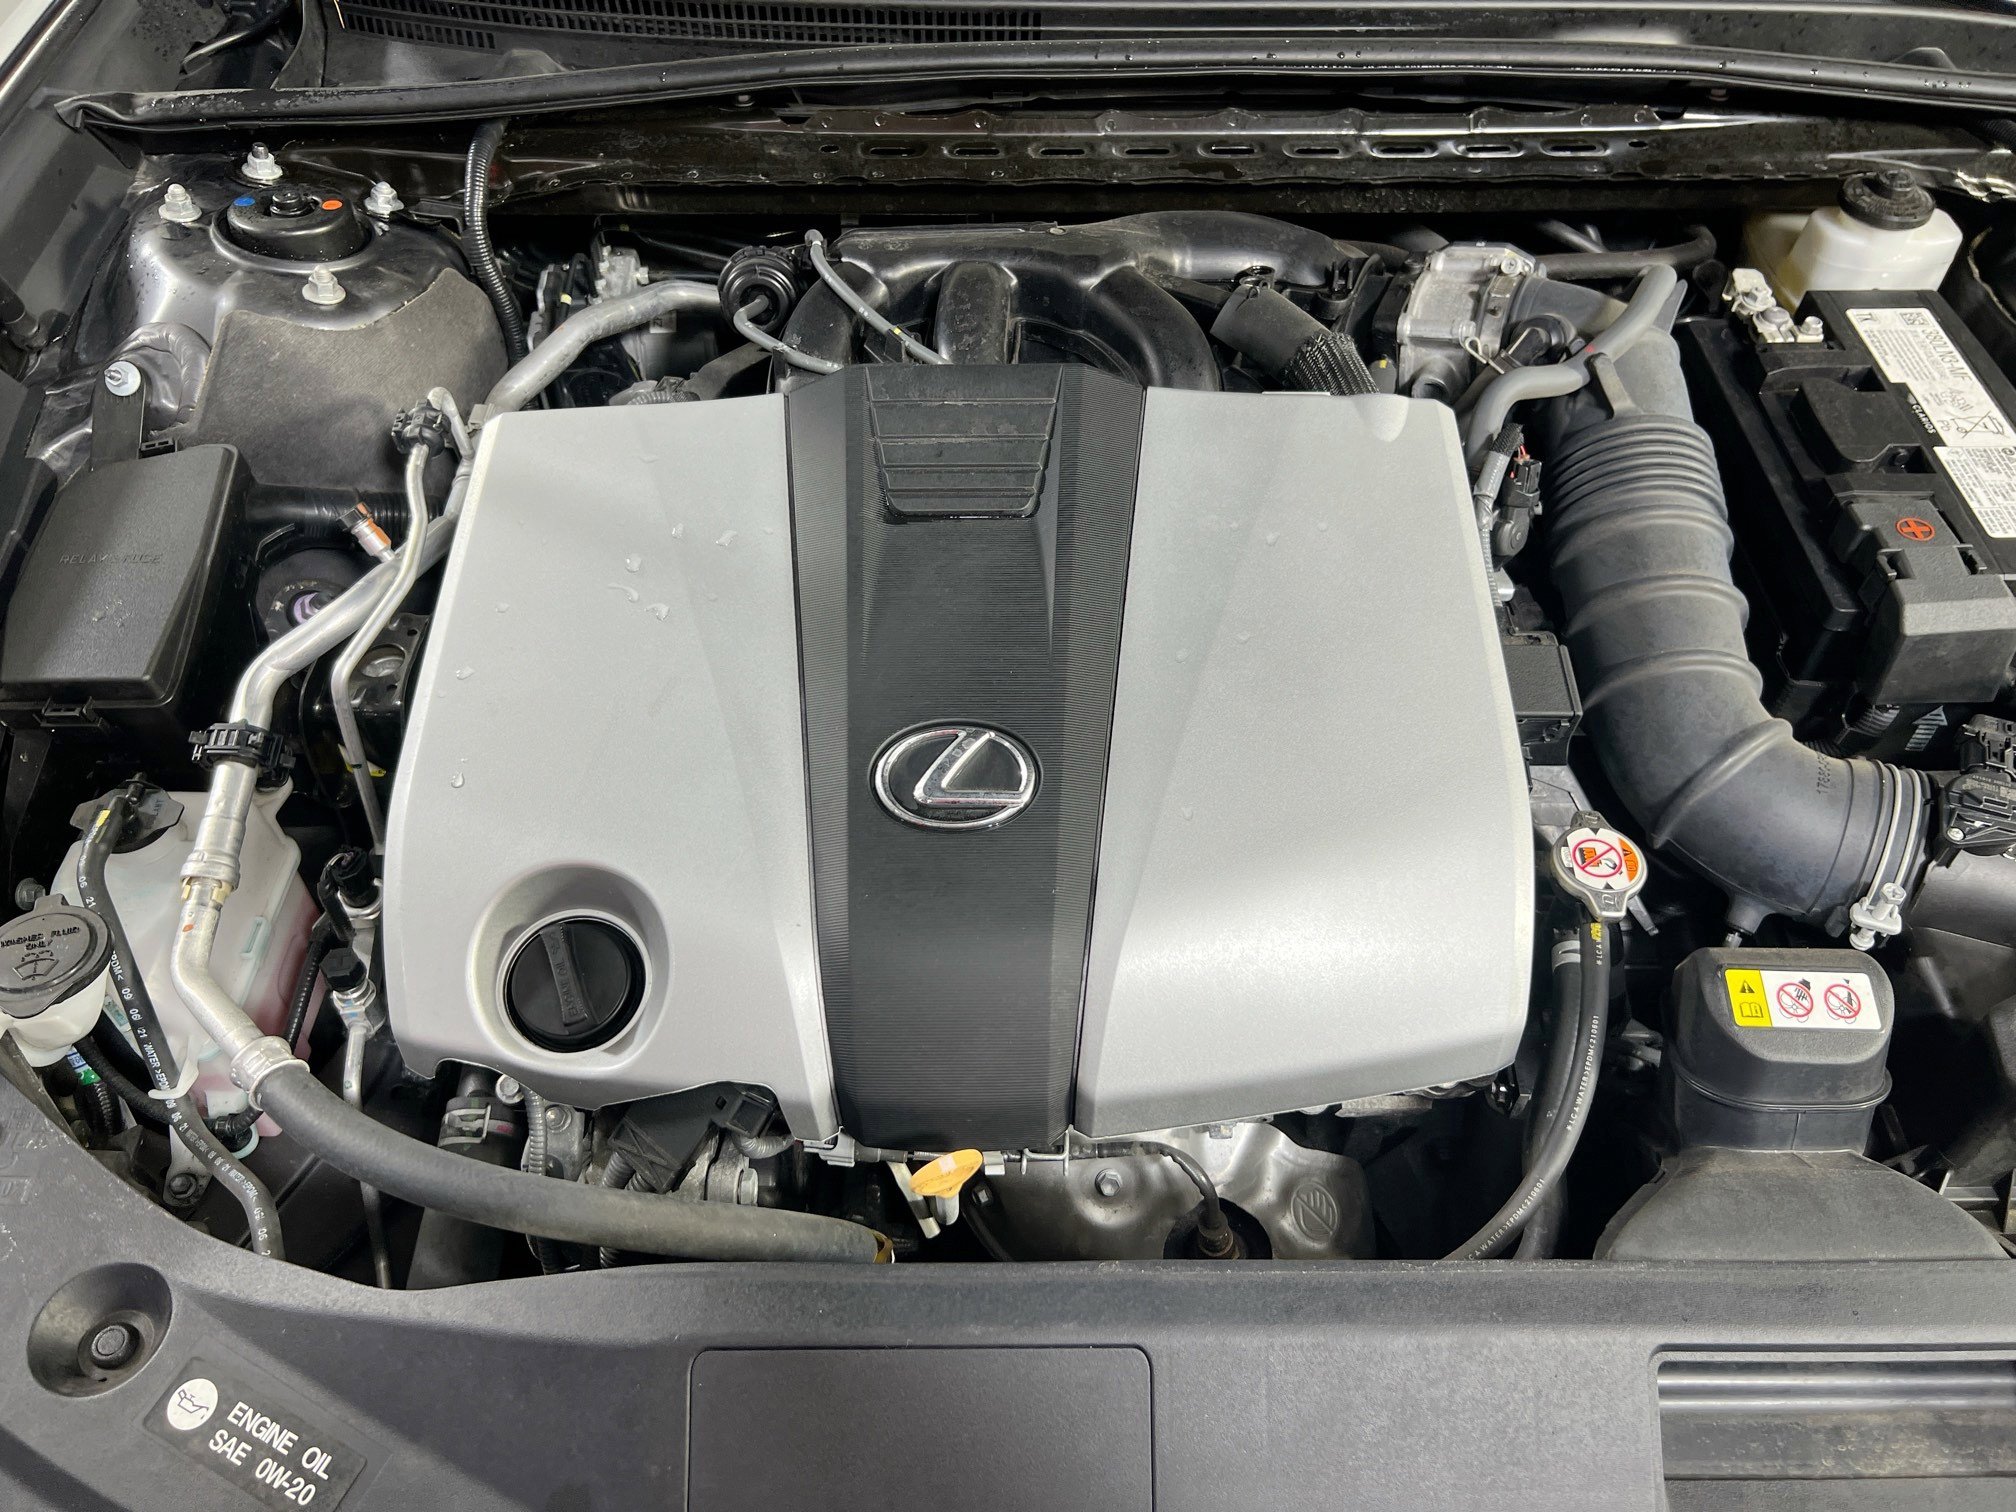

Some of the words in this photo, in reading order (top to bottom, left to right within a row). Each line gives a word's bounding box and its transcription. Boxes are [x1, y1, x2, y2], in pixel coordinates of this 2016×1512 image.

[1911, 404, 1937, 434] CLARIOS
[143, 1042, 160, 1069] WATER
[208, 1429, 253, 1466] SAE
[255, 1457, 316, 1506] 0W-20
[226, 1401, 300, 1456] ENGINE
[301, 1446, 333, 1481] OIL
